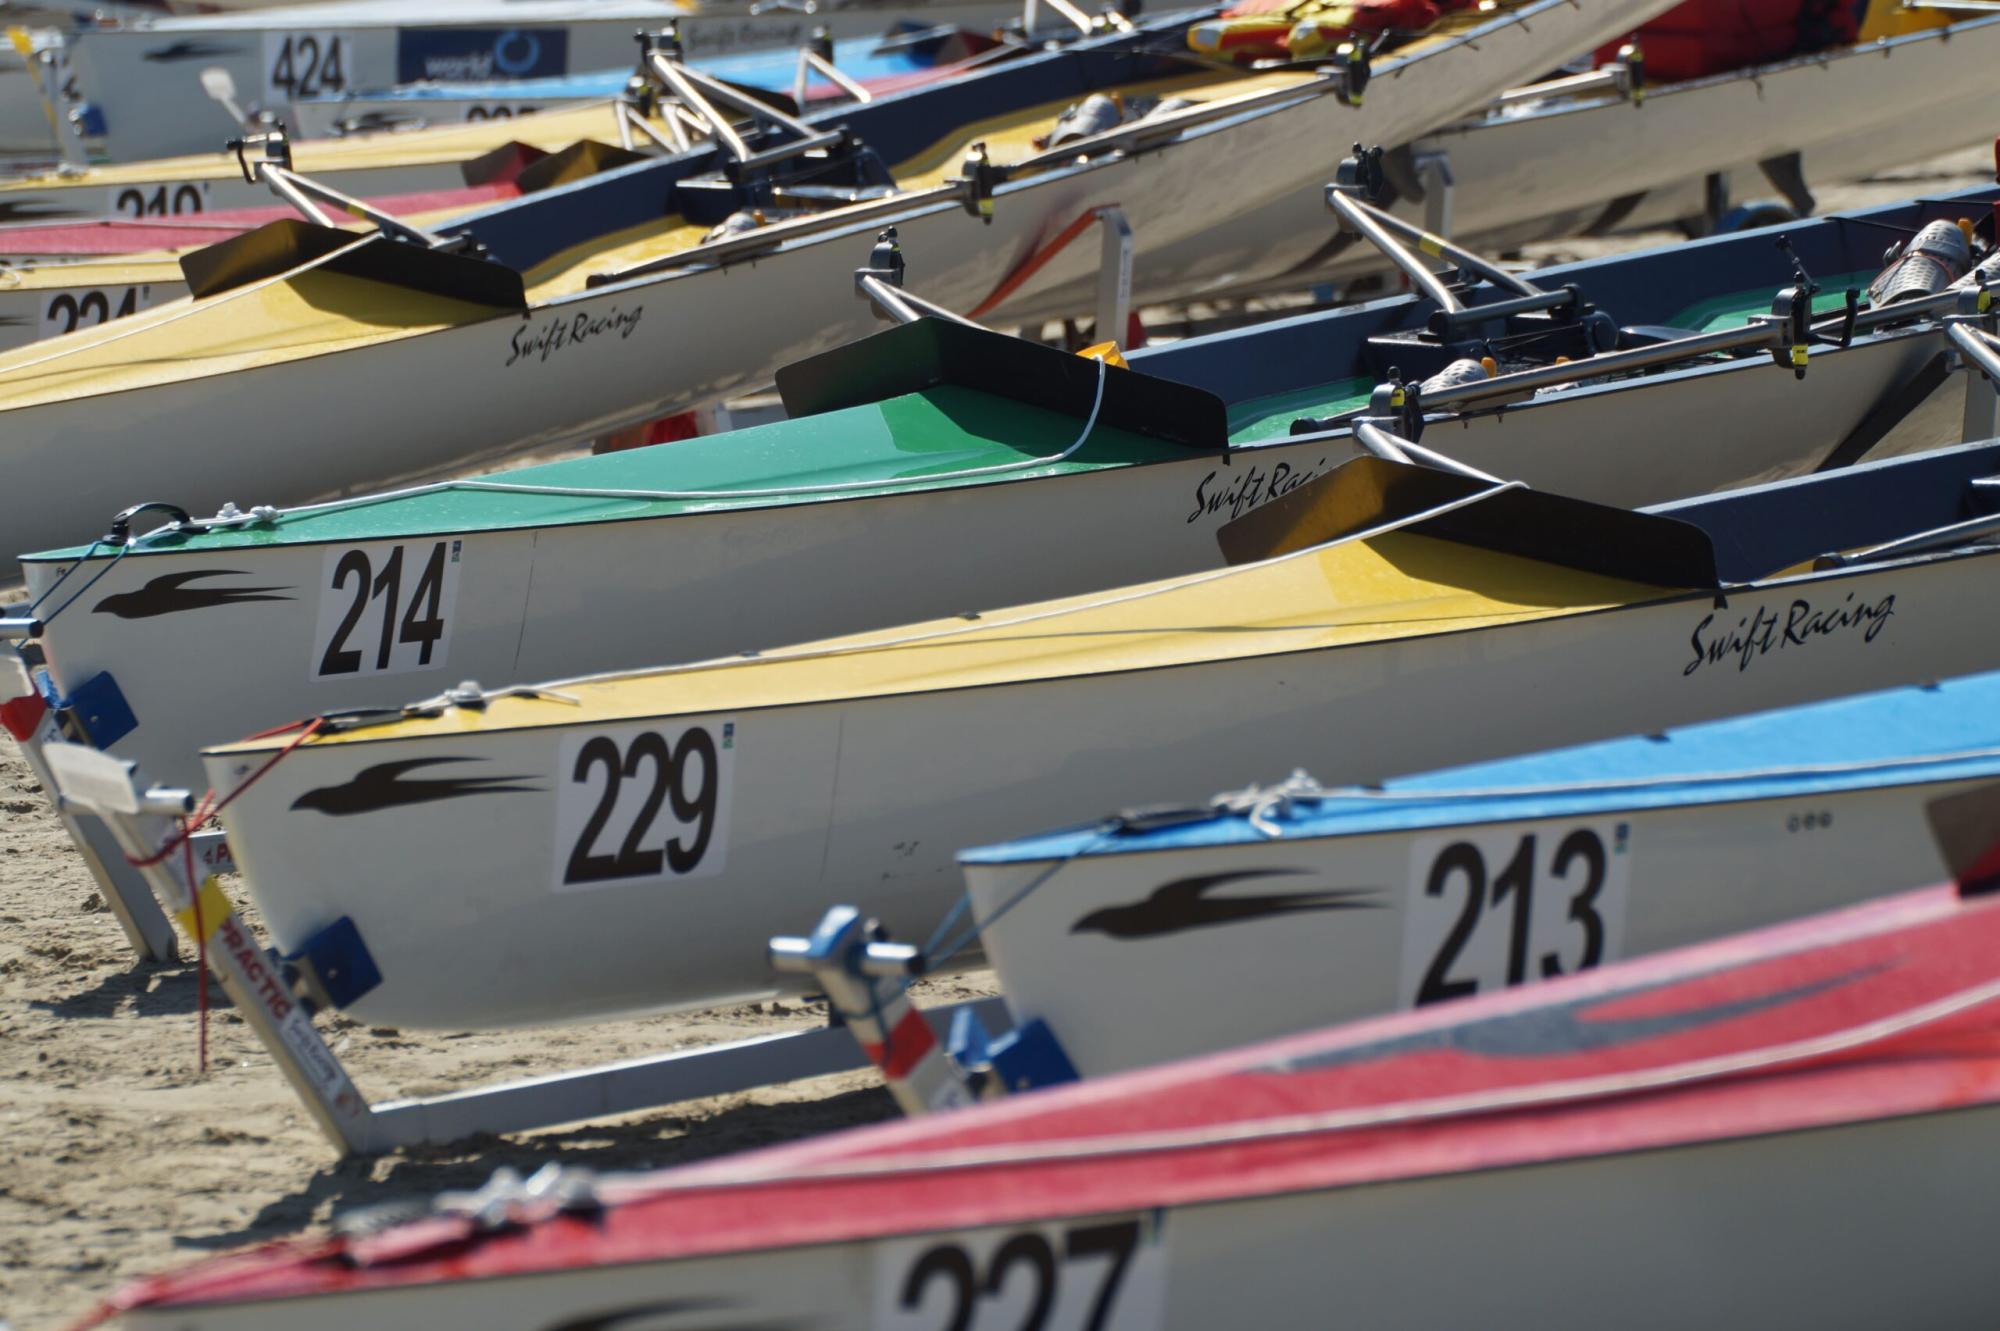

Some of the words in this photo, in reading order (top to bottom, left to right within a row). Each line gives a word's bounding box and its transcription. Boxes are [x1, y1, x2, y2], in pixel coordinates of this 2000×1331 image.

[272, 35, 345, 97] 424
[505, 317, 568, 367] Swift
[567, 305, 644, 345] Racing
[1187, 465, 1266, 524] Swift
[318, 541, 447, 676] 214
[1683, 605, 1778, 676] Swift
[1780, 592, 1896, 648] Racing
[563, 726, 718, 885] 229
[1413, 827, 1606, 1009] 213
